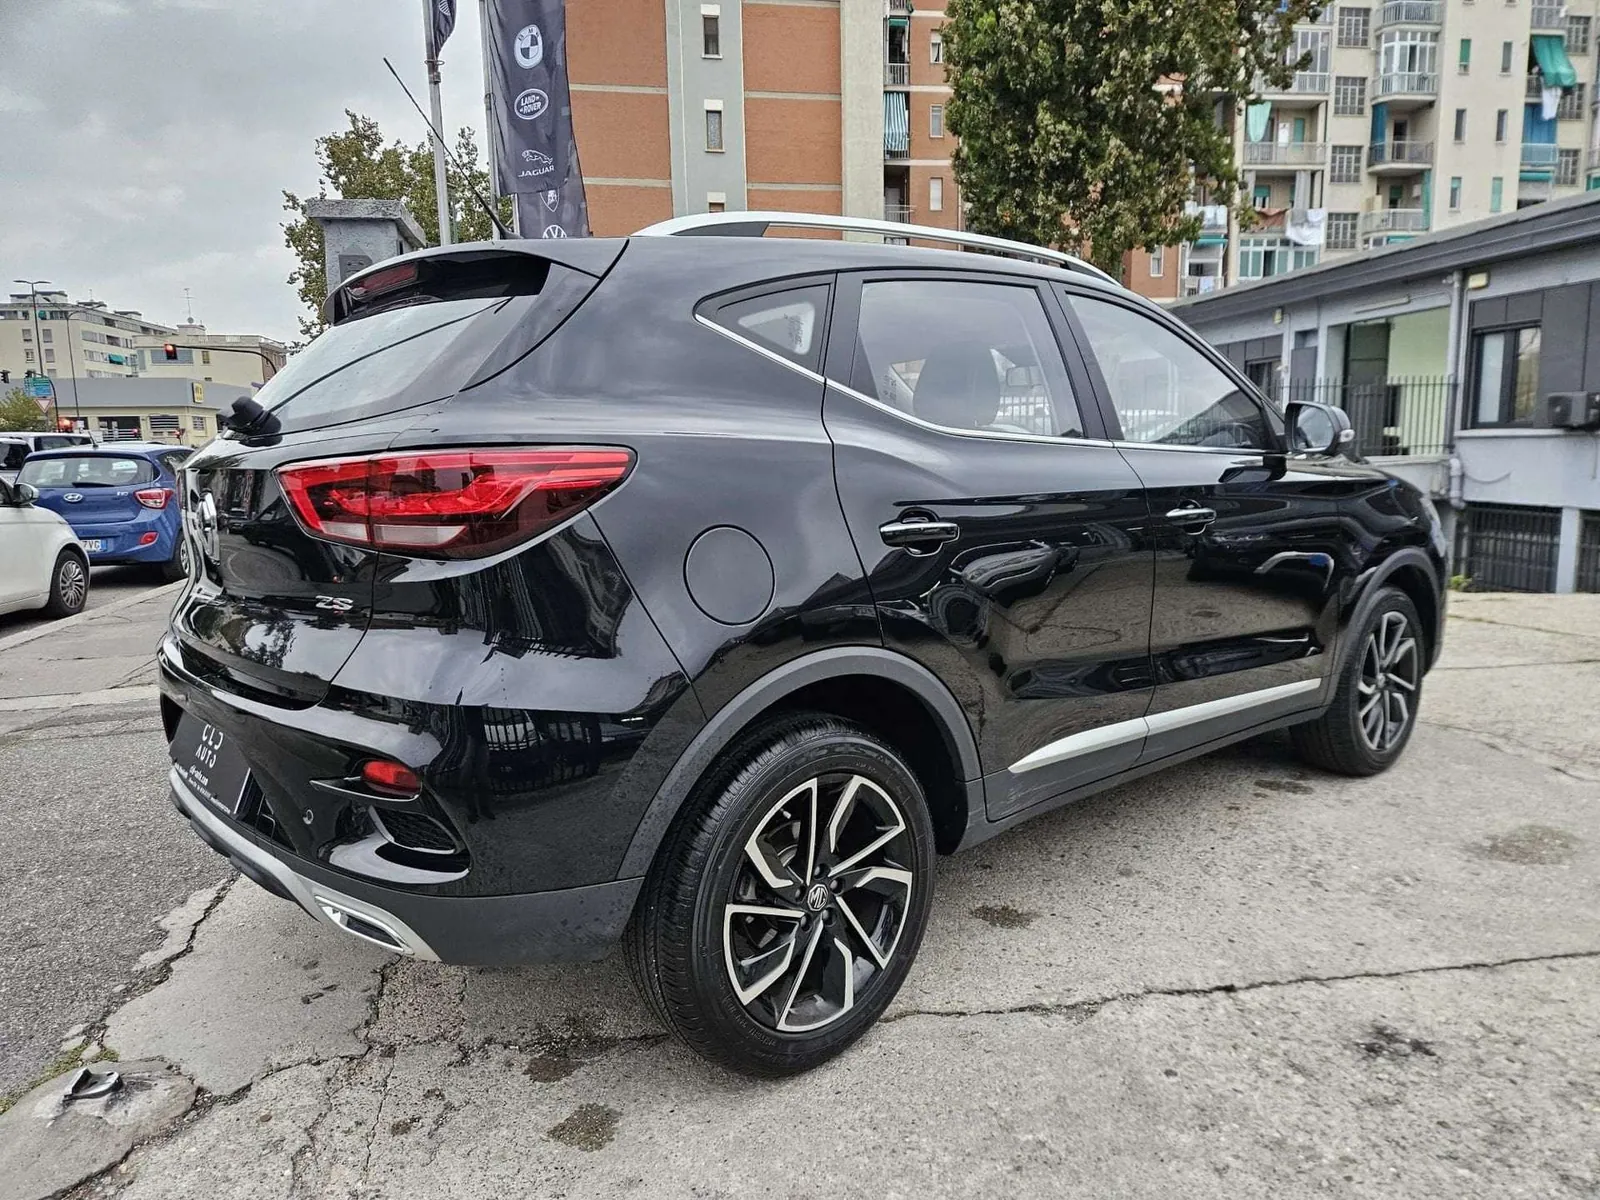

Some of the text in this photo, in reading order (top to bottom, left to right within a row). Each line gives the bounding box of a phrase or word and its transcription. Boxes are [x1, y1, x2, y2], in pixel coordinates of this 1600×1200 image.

[521, 95, 536, 106] LAND
[523, 102, 541, 114] ROVER
[518, 165, 555, 178] JAGUAR
[315, 595, 353, 611] ZS
[195, 744, 217, 768] AUTO
[810, 886, 827, 910] MG
